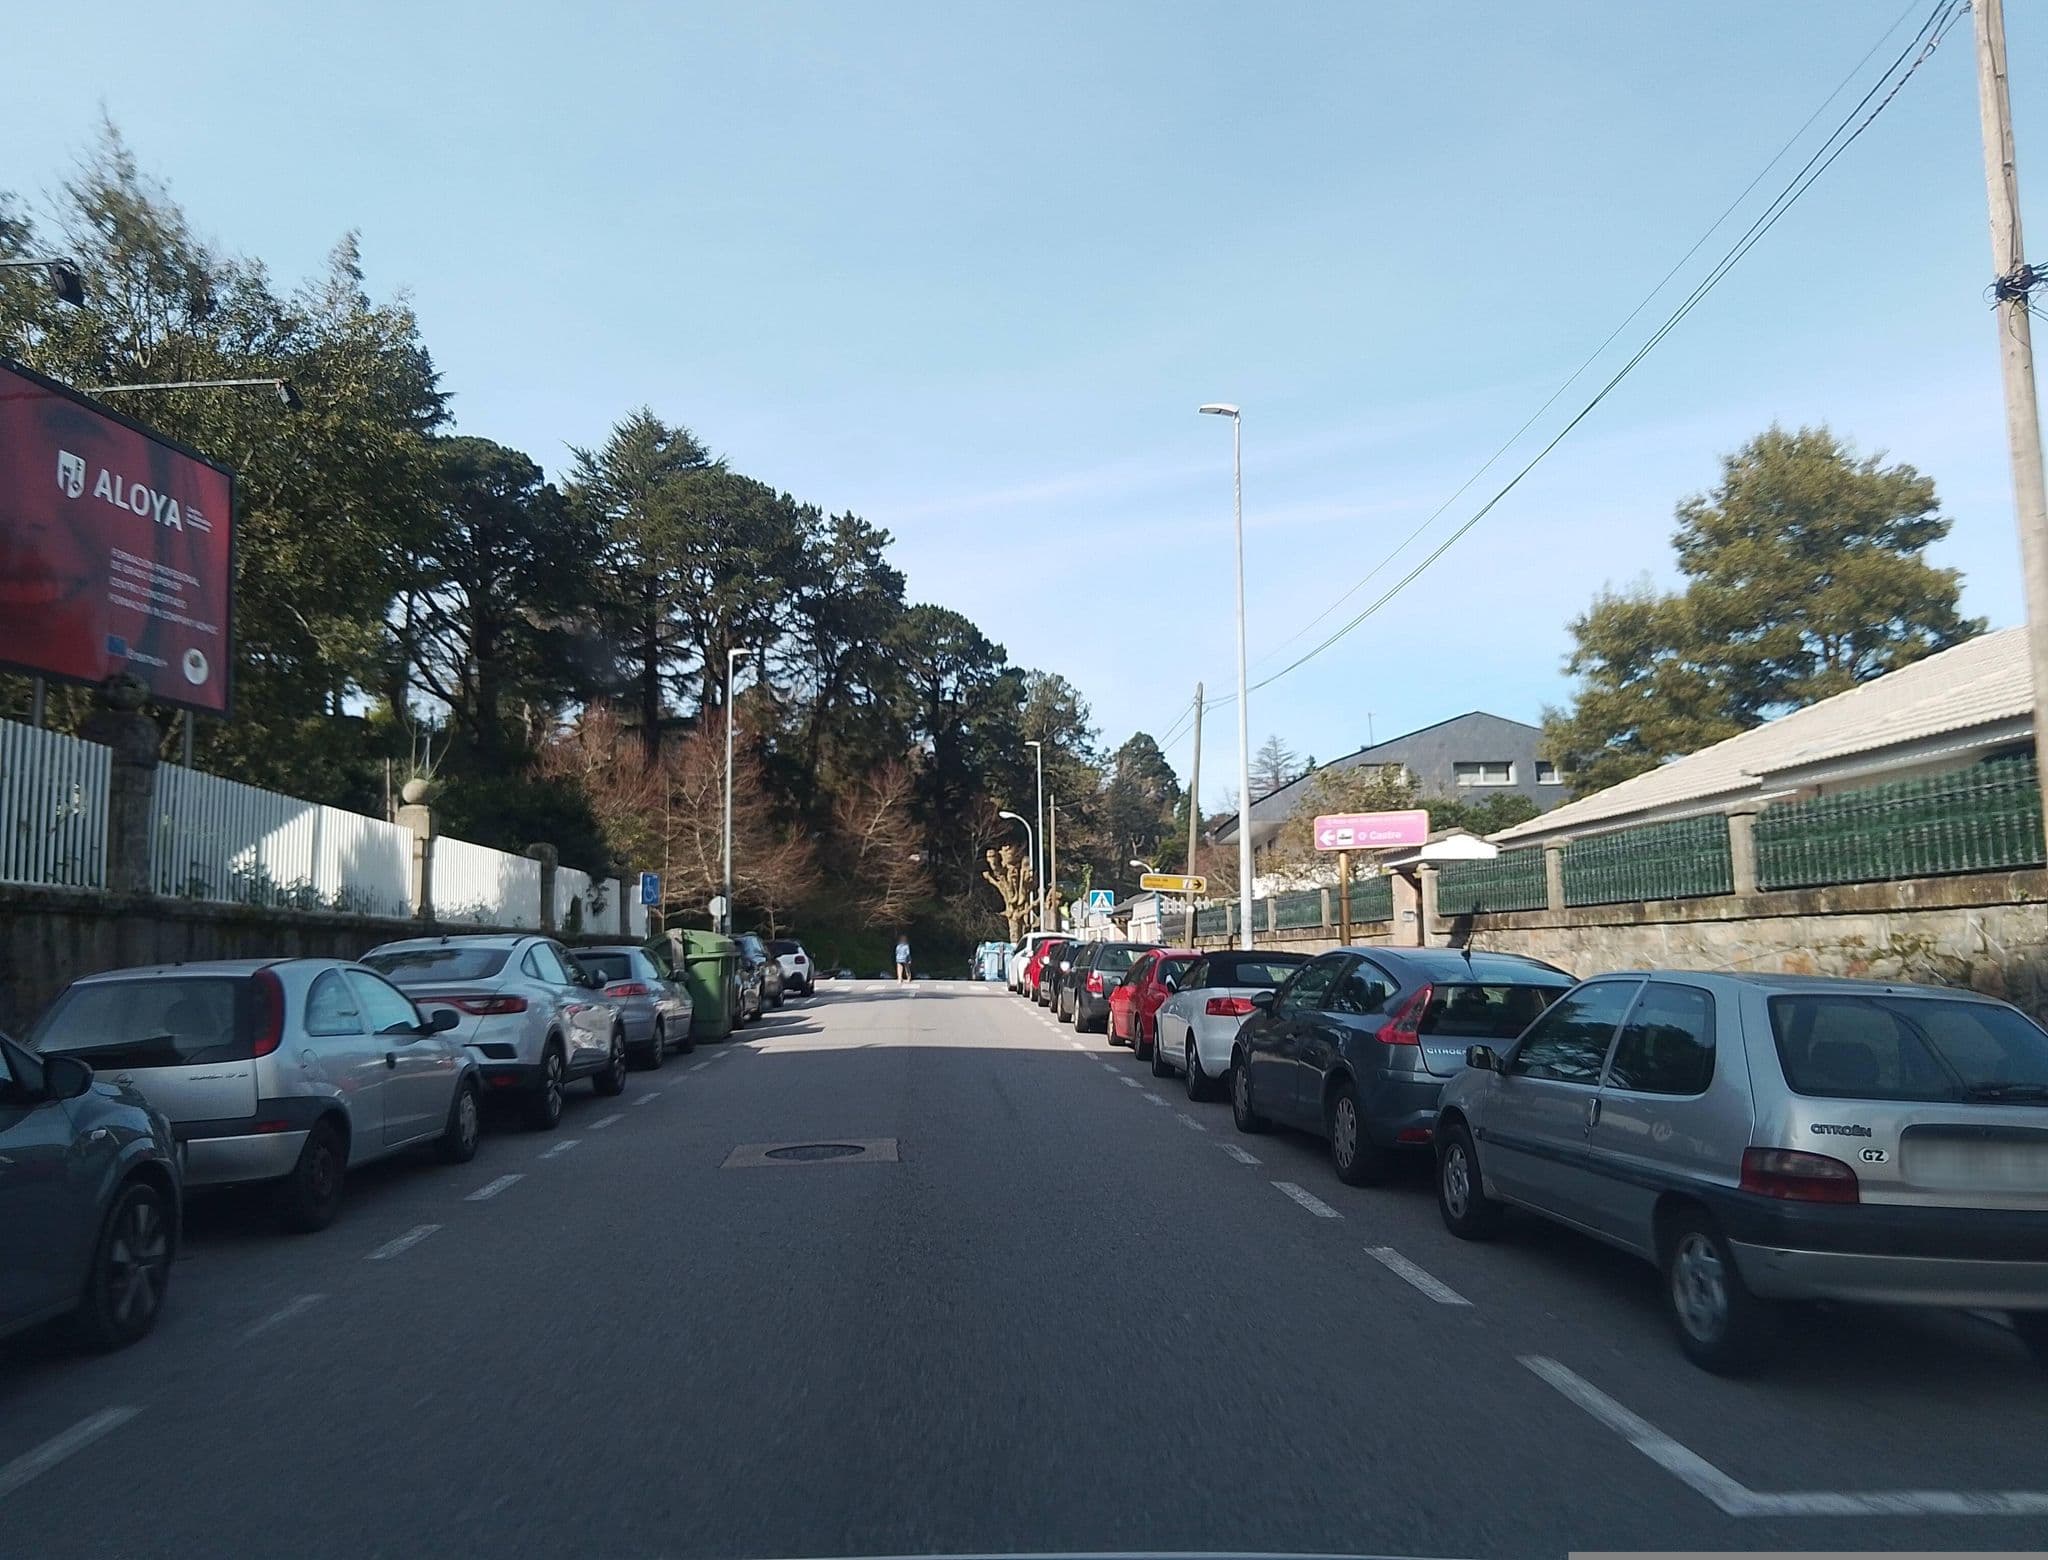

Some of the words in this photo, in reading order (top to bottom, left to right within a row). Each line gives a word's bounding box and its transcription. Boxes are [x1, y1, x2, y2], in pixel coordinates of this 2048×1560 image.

[93, 468, 183, 532] ALOYA
[1370, 831, 1402, 841] Castro
[1863, 1149, 1884, 1162] GZ
